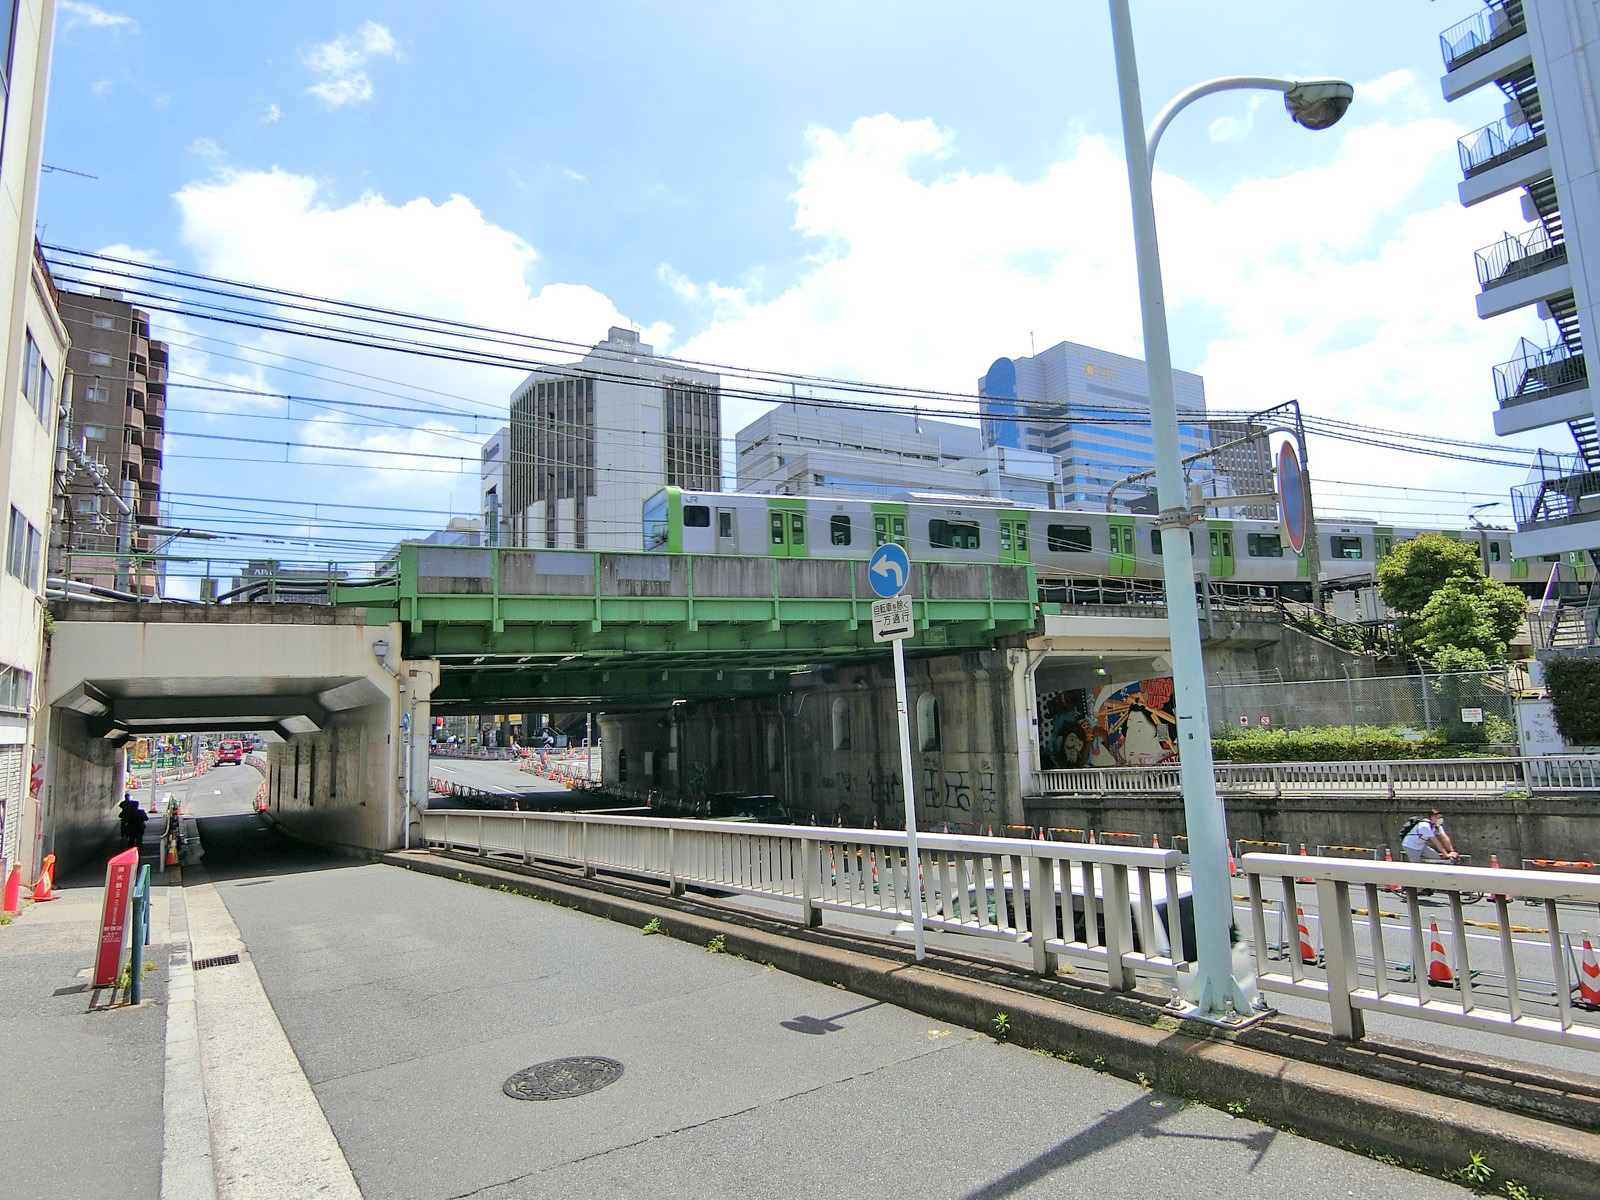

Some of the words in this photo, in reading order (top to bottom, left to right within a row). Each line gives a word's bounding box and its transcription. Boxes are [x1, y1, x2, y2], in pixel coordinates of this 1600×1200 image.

[685, 495, 699, 503] JR
[874, 600, 908, 615] 自転車を除く
[874, 612, 909, 625] 一方通行
[1140, 678, 1173, 696] TURN
[1147, 695, 1169, 709] UP
